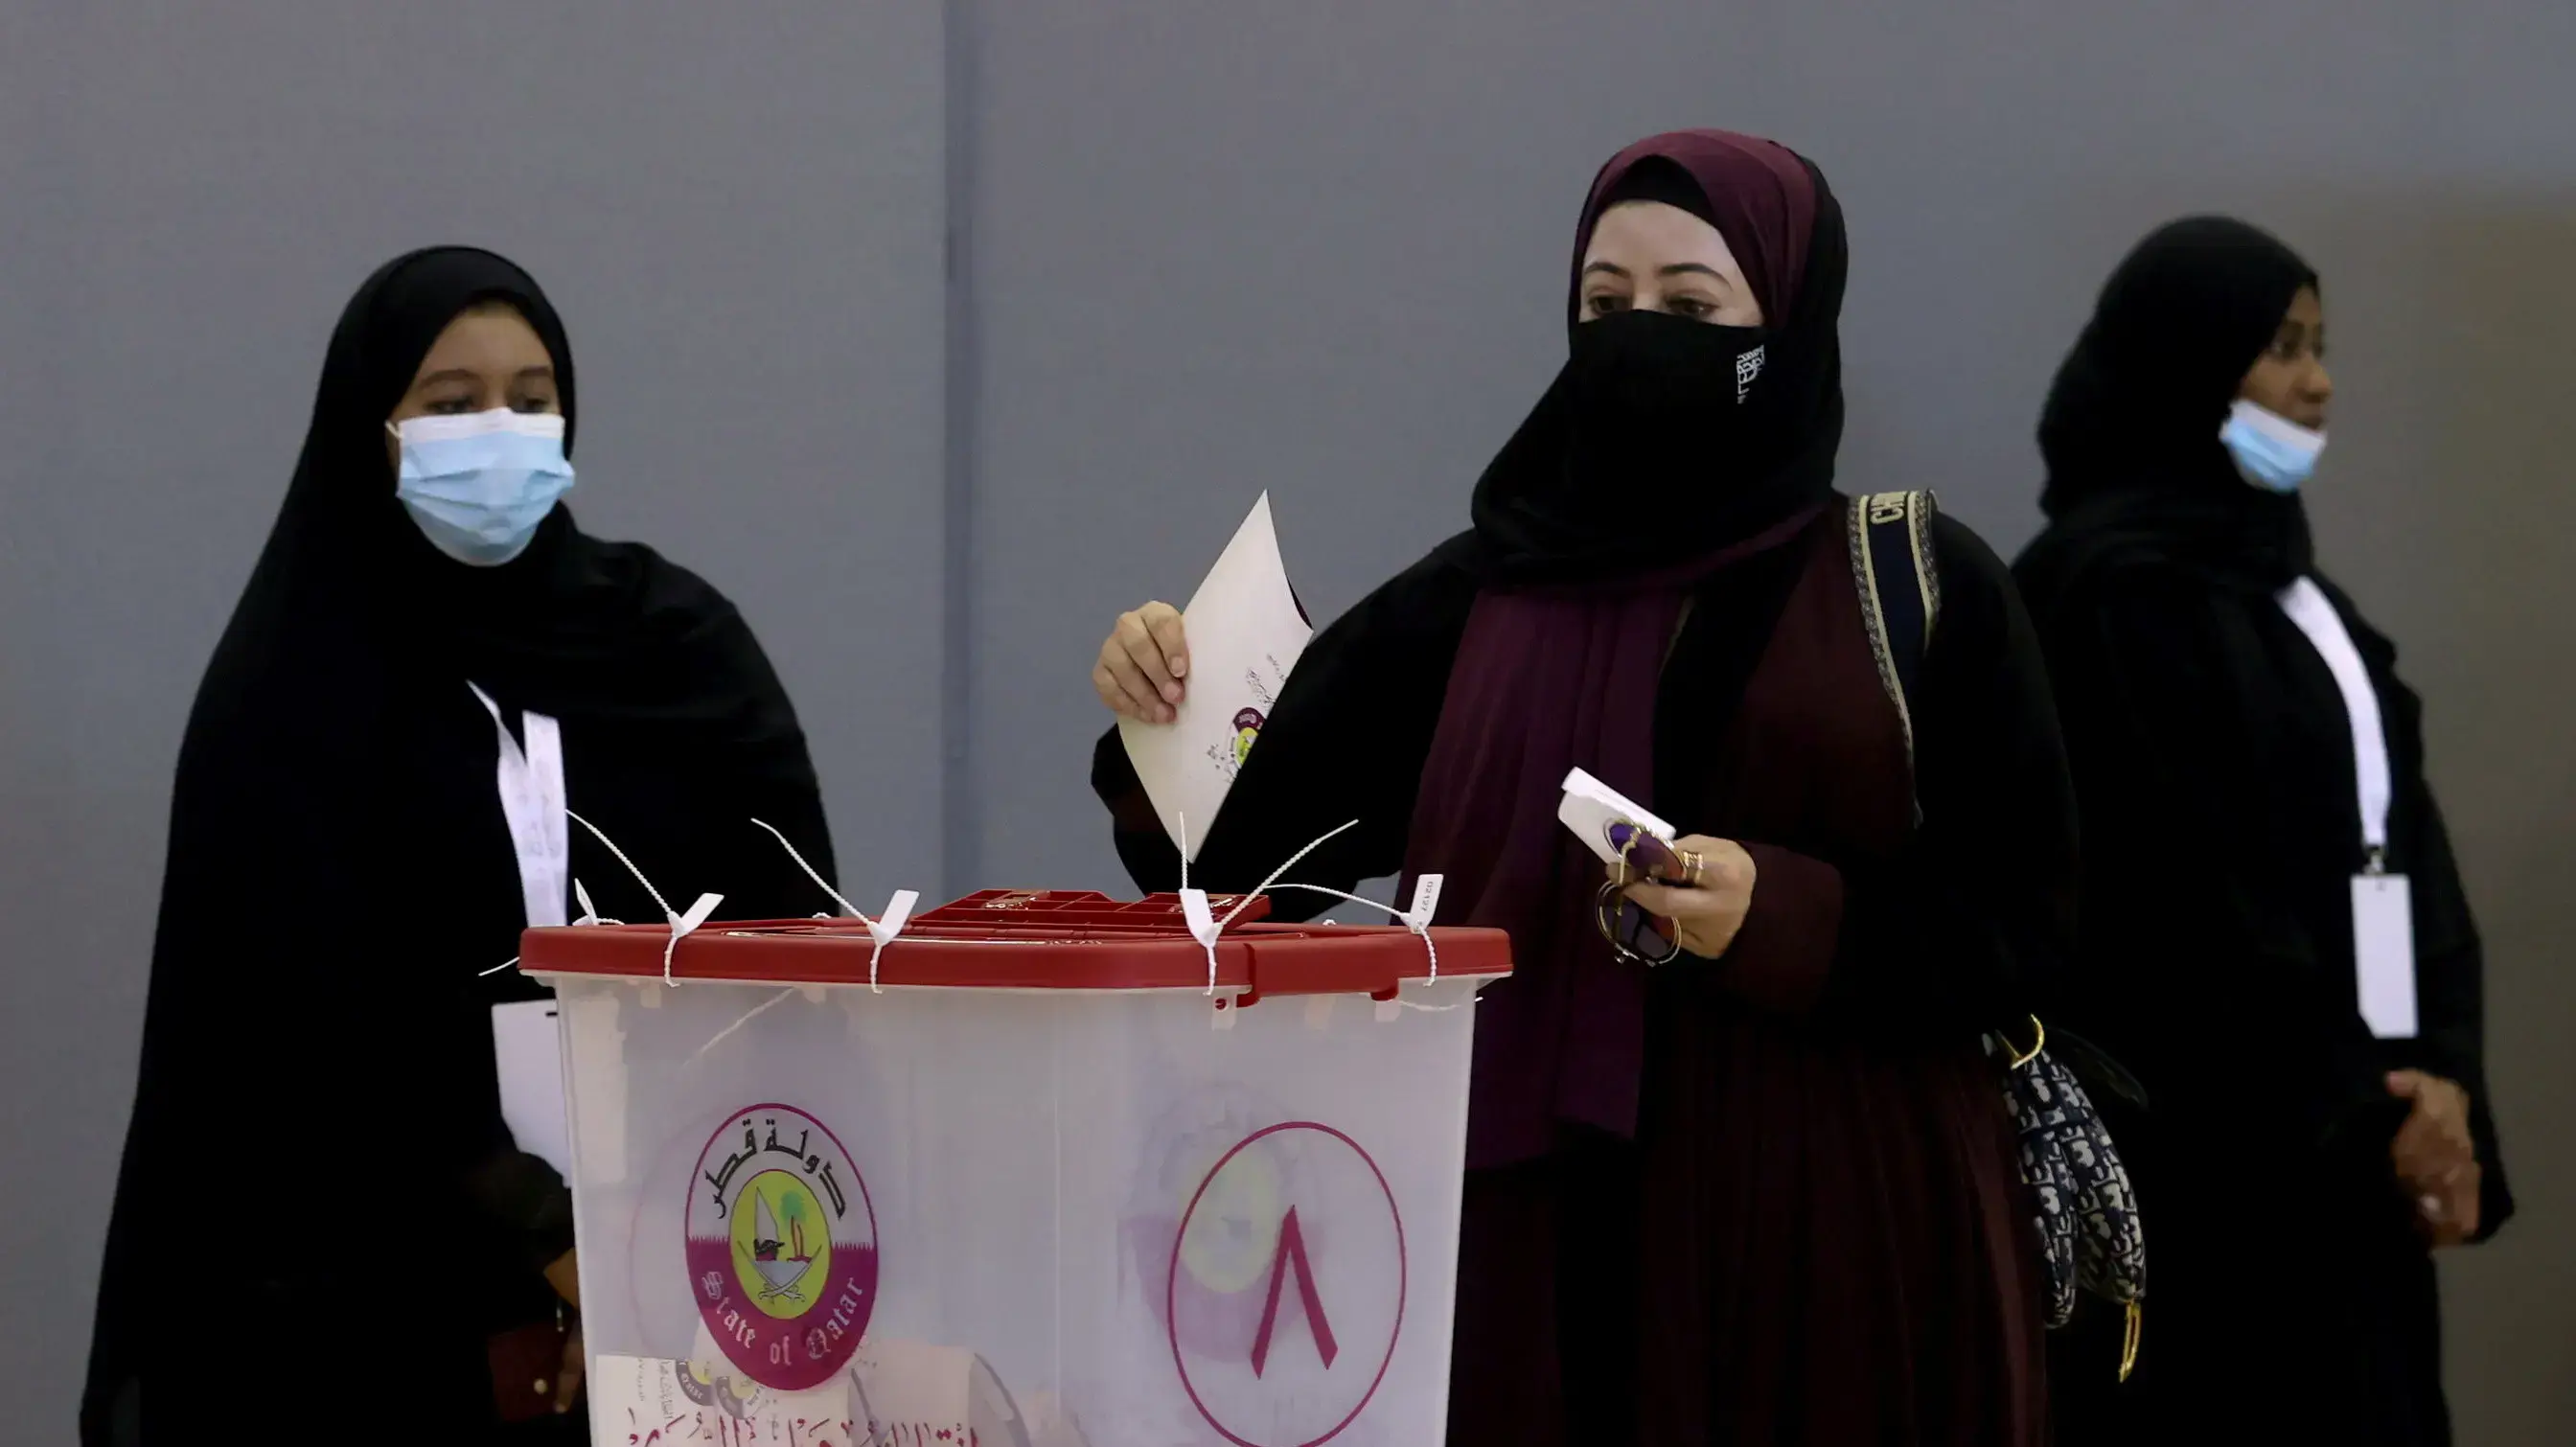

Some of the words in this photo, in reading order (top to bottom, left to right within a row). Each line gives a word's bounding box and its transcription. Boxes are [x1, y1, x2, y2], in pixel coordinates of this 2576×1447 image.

[704, 1118, 757, 1220] قطر
[764, 1118, 846, 1221] دولة
[702, 1270, 757, 1349] State
[770, 1335, 793, 1367] of
[806, 1276, 863, 1361] Qatar
[1251, 1204, 1339, 1380] ٨
